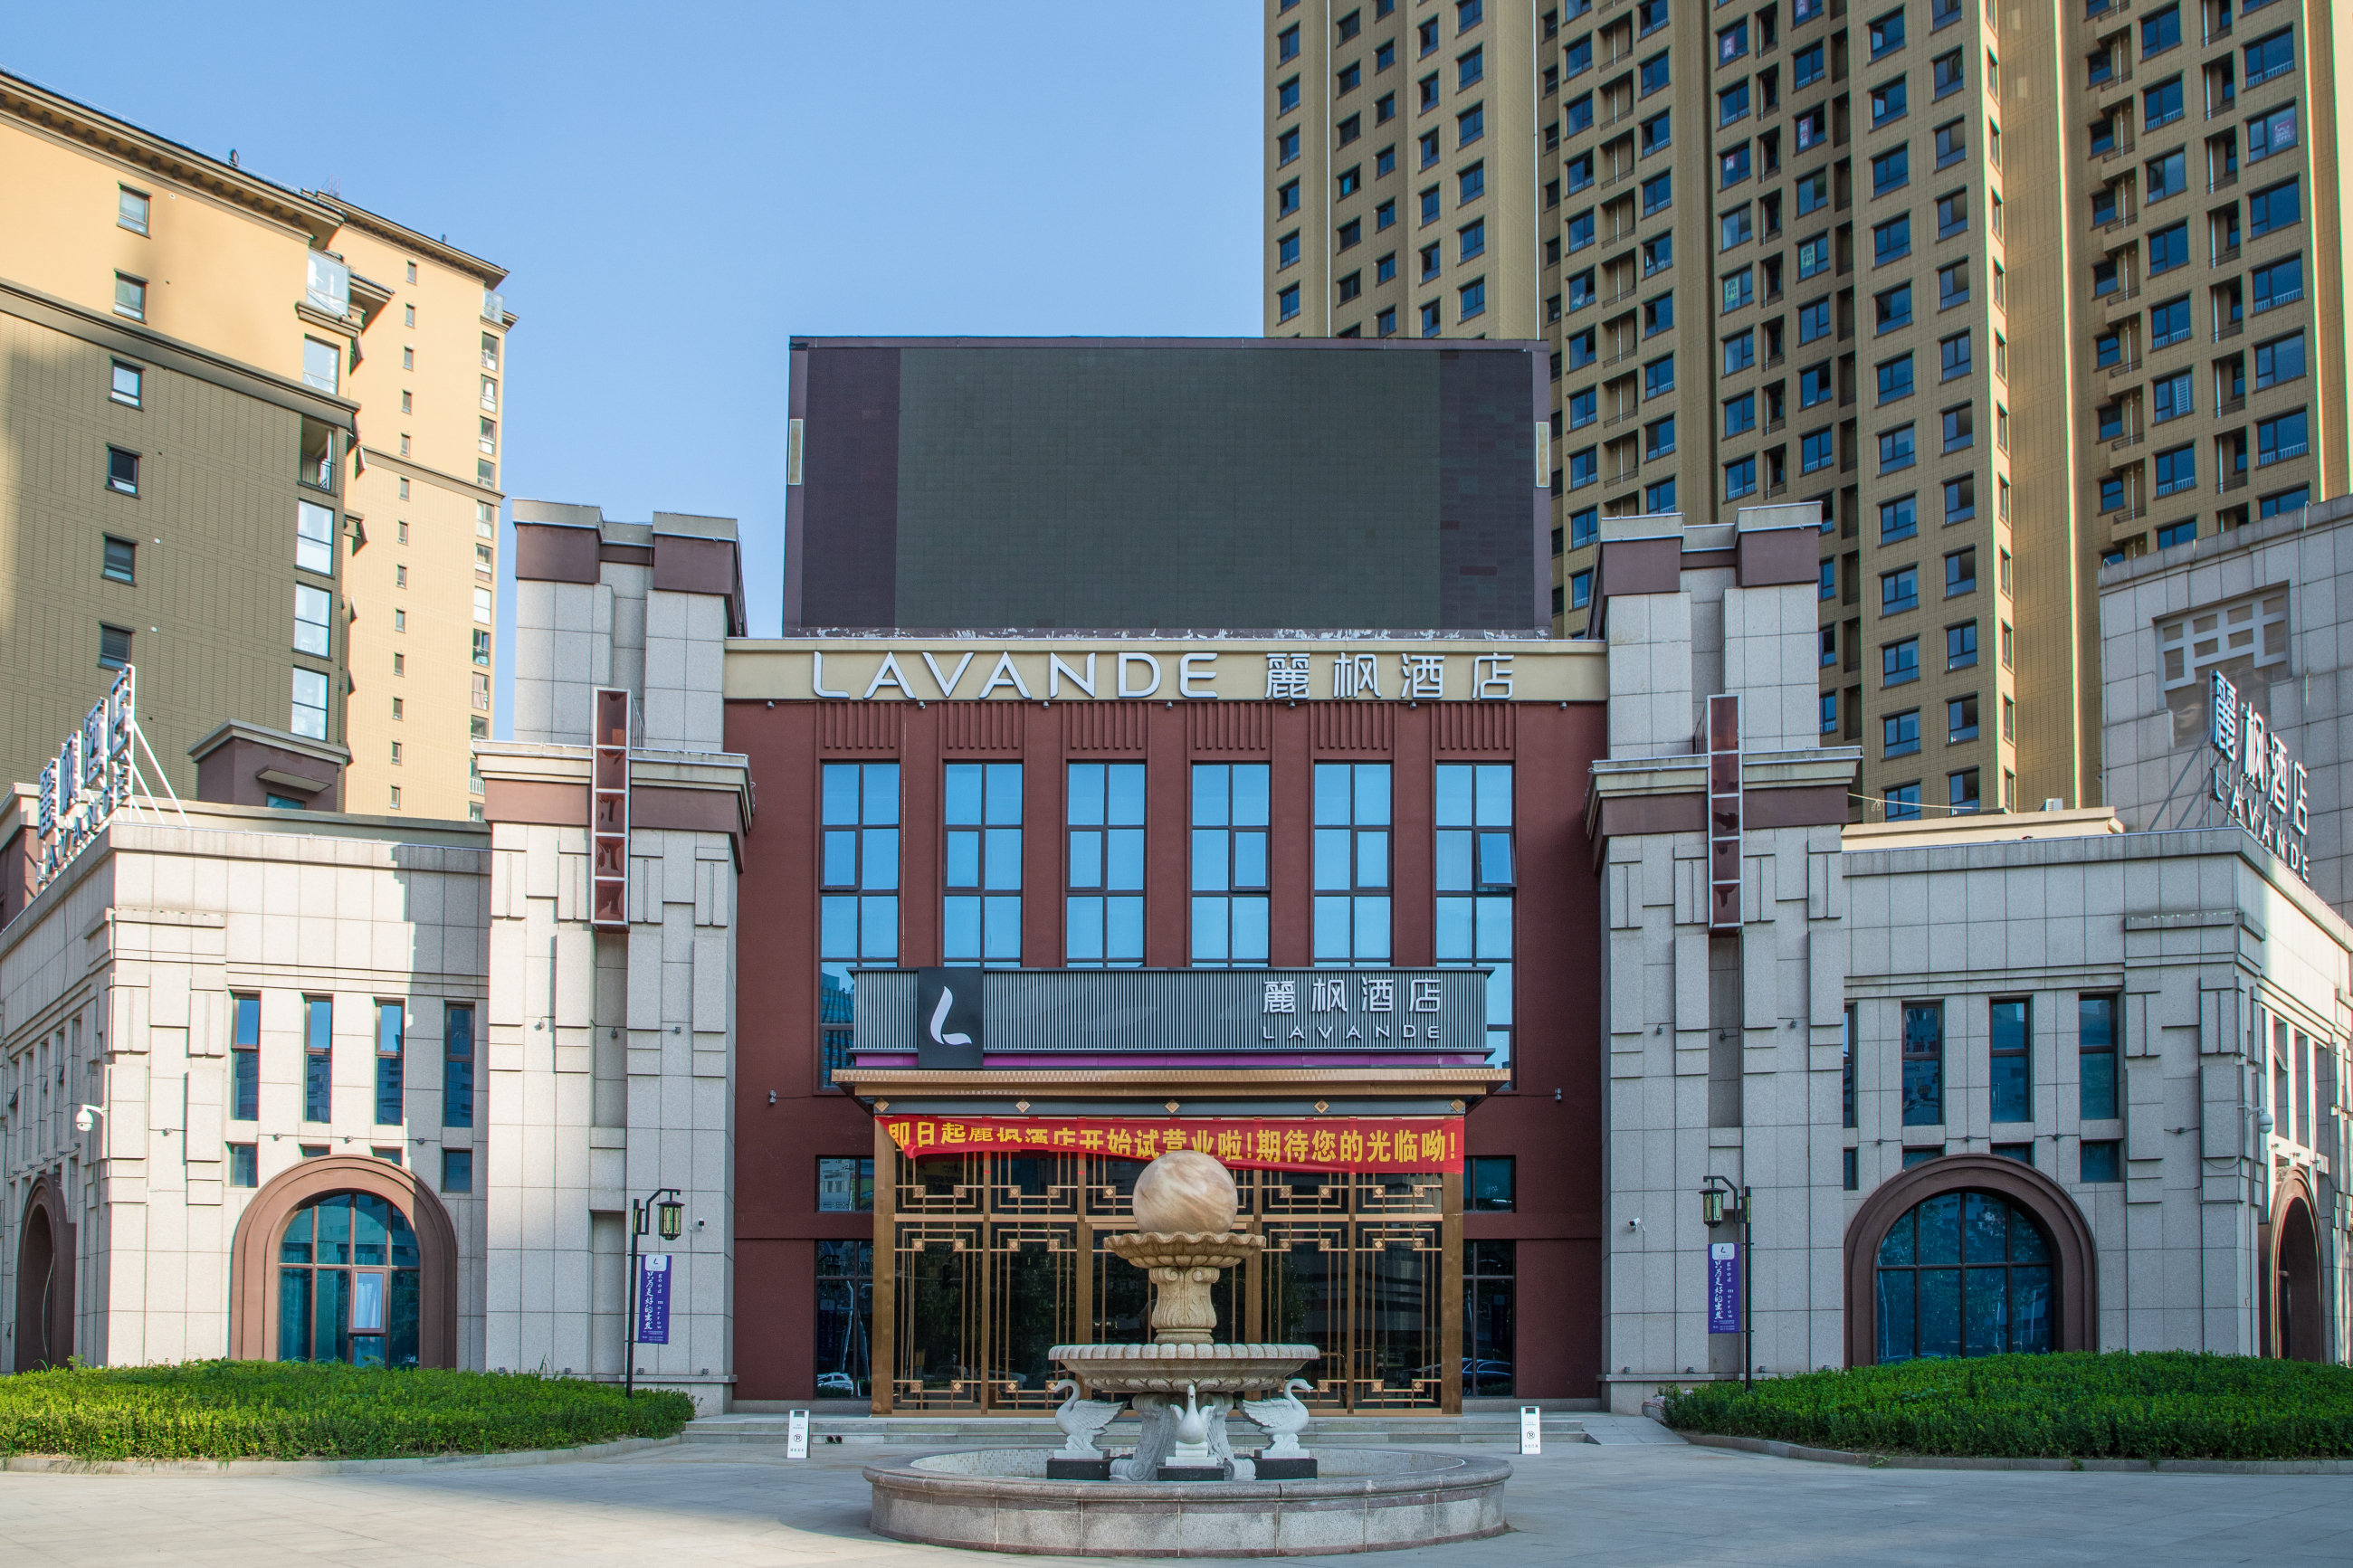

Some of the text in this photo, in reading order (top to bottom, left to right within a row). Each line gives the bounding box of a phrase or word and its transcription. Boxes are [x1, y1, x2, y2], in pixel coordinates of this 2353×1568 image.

[813, 651, 1515, 700] LAVANDE 麗枫酒店
[2213, 670, 2308, 836] 麗枫酒店
[2212, 767, 2310, 883] LAVANDE
[1262, 976, 1441, 1013] 麗枫酒店
[1262, 1024, 1441, 1040] LAVANDE
